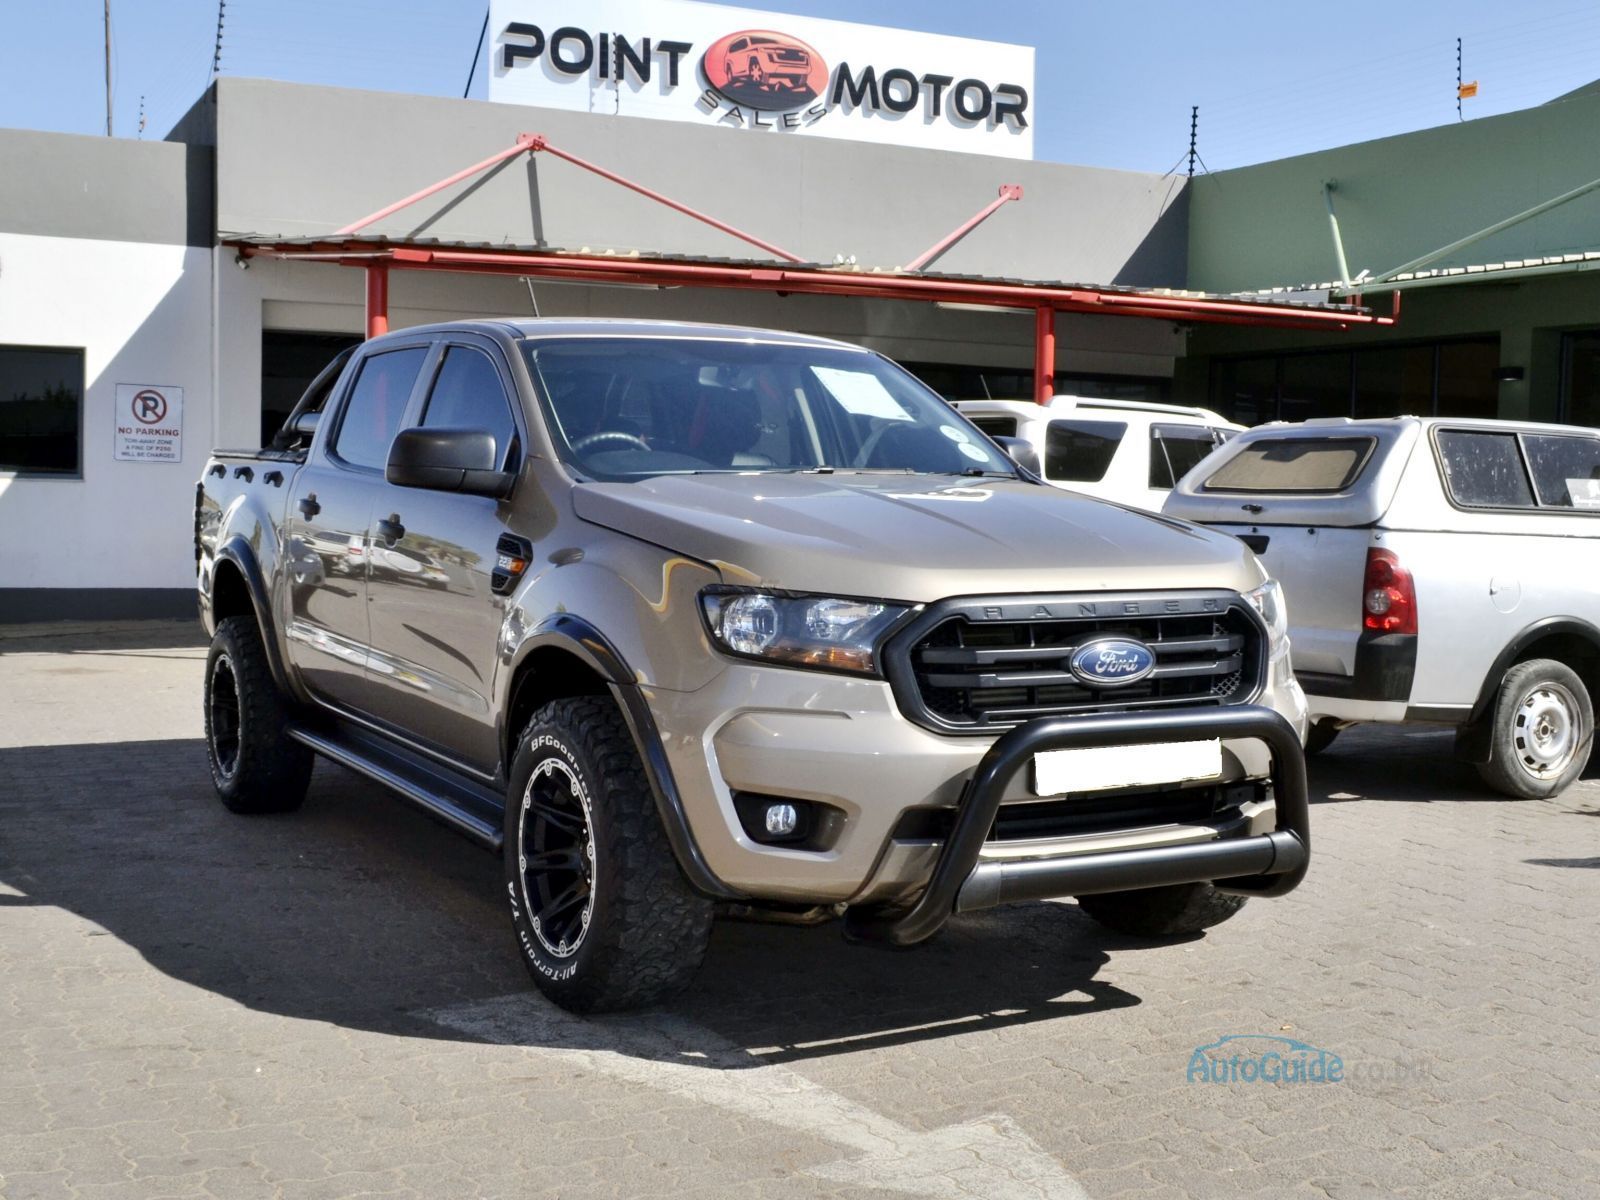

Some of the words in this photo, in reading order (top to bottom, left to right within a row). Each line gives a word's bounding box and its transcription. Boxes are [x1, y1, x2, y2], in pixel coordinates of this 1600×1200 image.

[502, 21, 693, 87] POINT
[832, 61, 1028, 128] MOTOR
[700, 88, 828, 129] SALES
[135, 427, 179, 437] PARKING
[983, 599, 1219, 620] RANGER
[1095, 649, 1139, 673] Ford
[531, 735, 593, 812] BFGoodrich
